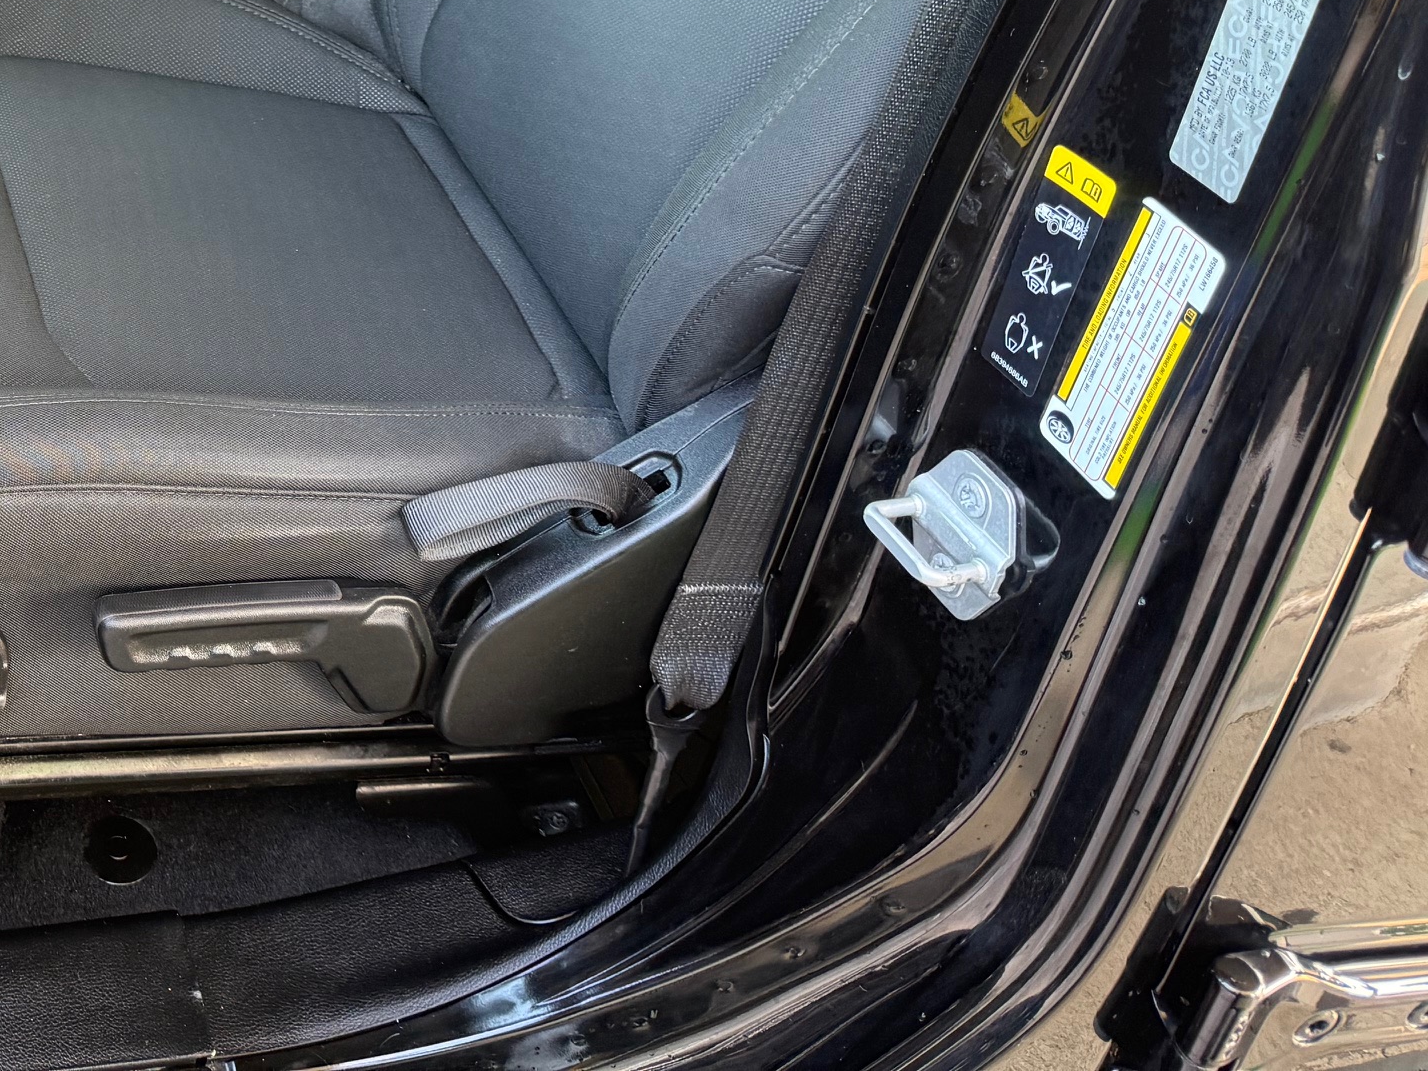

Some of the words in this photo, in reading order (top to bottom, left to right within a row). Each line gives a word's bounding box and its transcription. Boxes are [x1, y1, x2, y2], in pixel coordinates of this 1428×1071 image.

[1292, 8, 1306, 25] 250
[1209, 50, 1225, 73] LLC
[1265, 47, 1277, 61] LB
[1203, 69, 1218, 87] US
[1220, 56, 1235, 80] 10-19
[1223, 84, 1237, 105] 1225
[1230, 73, 1242, 86] KG
[1237, 46, 1252, 67] 2700
[1245, 35, 1256, 48] LB
[1258, 59, 1273, 80] 3000
[1196, 84, 1212, 107] FCA
[1250, 86, 1262, 100] KG
[1193, 105, 1204, 118] BY
[1243, 98, 1257, 118] 1361
[1187, 262, 1195, 272] 36
[1191, 253, 1199, 264] PSI
[1198, 255, 1219, 292] LW166458
[1081, 335, 1091, 350] TIRE
[1087, 322, 1097, 337] AND
[1093, 296, 1109, 324] LOADING
[1104, 257, 1127, 299] INFORMATION
[1087, 357, 1101, 383] COMBINED
[1098, 339, 1110, 359] WEIGHT
[1107, 332, 1113, 340] OF
[1110, 303, 1127, 333] OCCUPANTS
[1123, 292, 1132, 305] AND
[1128, 275, 1140, 294] CARGO
[1136, 255, 1149, 277] SHOULD
[1146, 238, 1157, 257] NEVER
[1154, 218, 1166, 240] EXCEED
[1111, 352, 1122, 370] FRONT
[1136, 301, 1146, 317] REAR
[1154, 260, 1166, 279] SPARE
[1161, 318, 1168, 327] 36
[1164, 308, 1172, 320] PSI
[1085, 434, 1097, 455] ORIGINAL
[1098, 414, 1106, 426] SIZE
[1113, 365, 1129, 395] 245/75R17
[1126, 352, 1136, 367] 112S
[1138, 313, 1155, 343] 245/75R17
[1152, 298, 1162, 314] 112S
[1164, 257, 1181, 288] 245/75R17
[1178, 243, 1188, 259] 112S
[1136, 371, 1142, 381] 36
[1116, 453, 1124, 464] SEE
[1130, 413, 1143, 435] MANUAL
[1140, 402, 1148, 415] FOR
[1145, 374, 1161, 404] ADDITIONAL
[1158, 340, 1178, 376] INFORMATION
